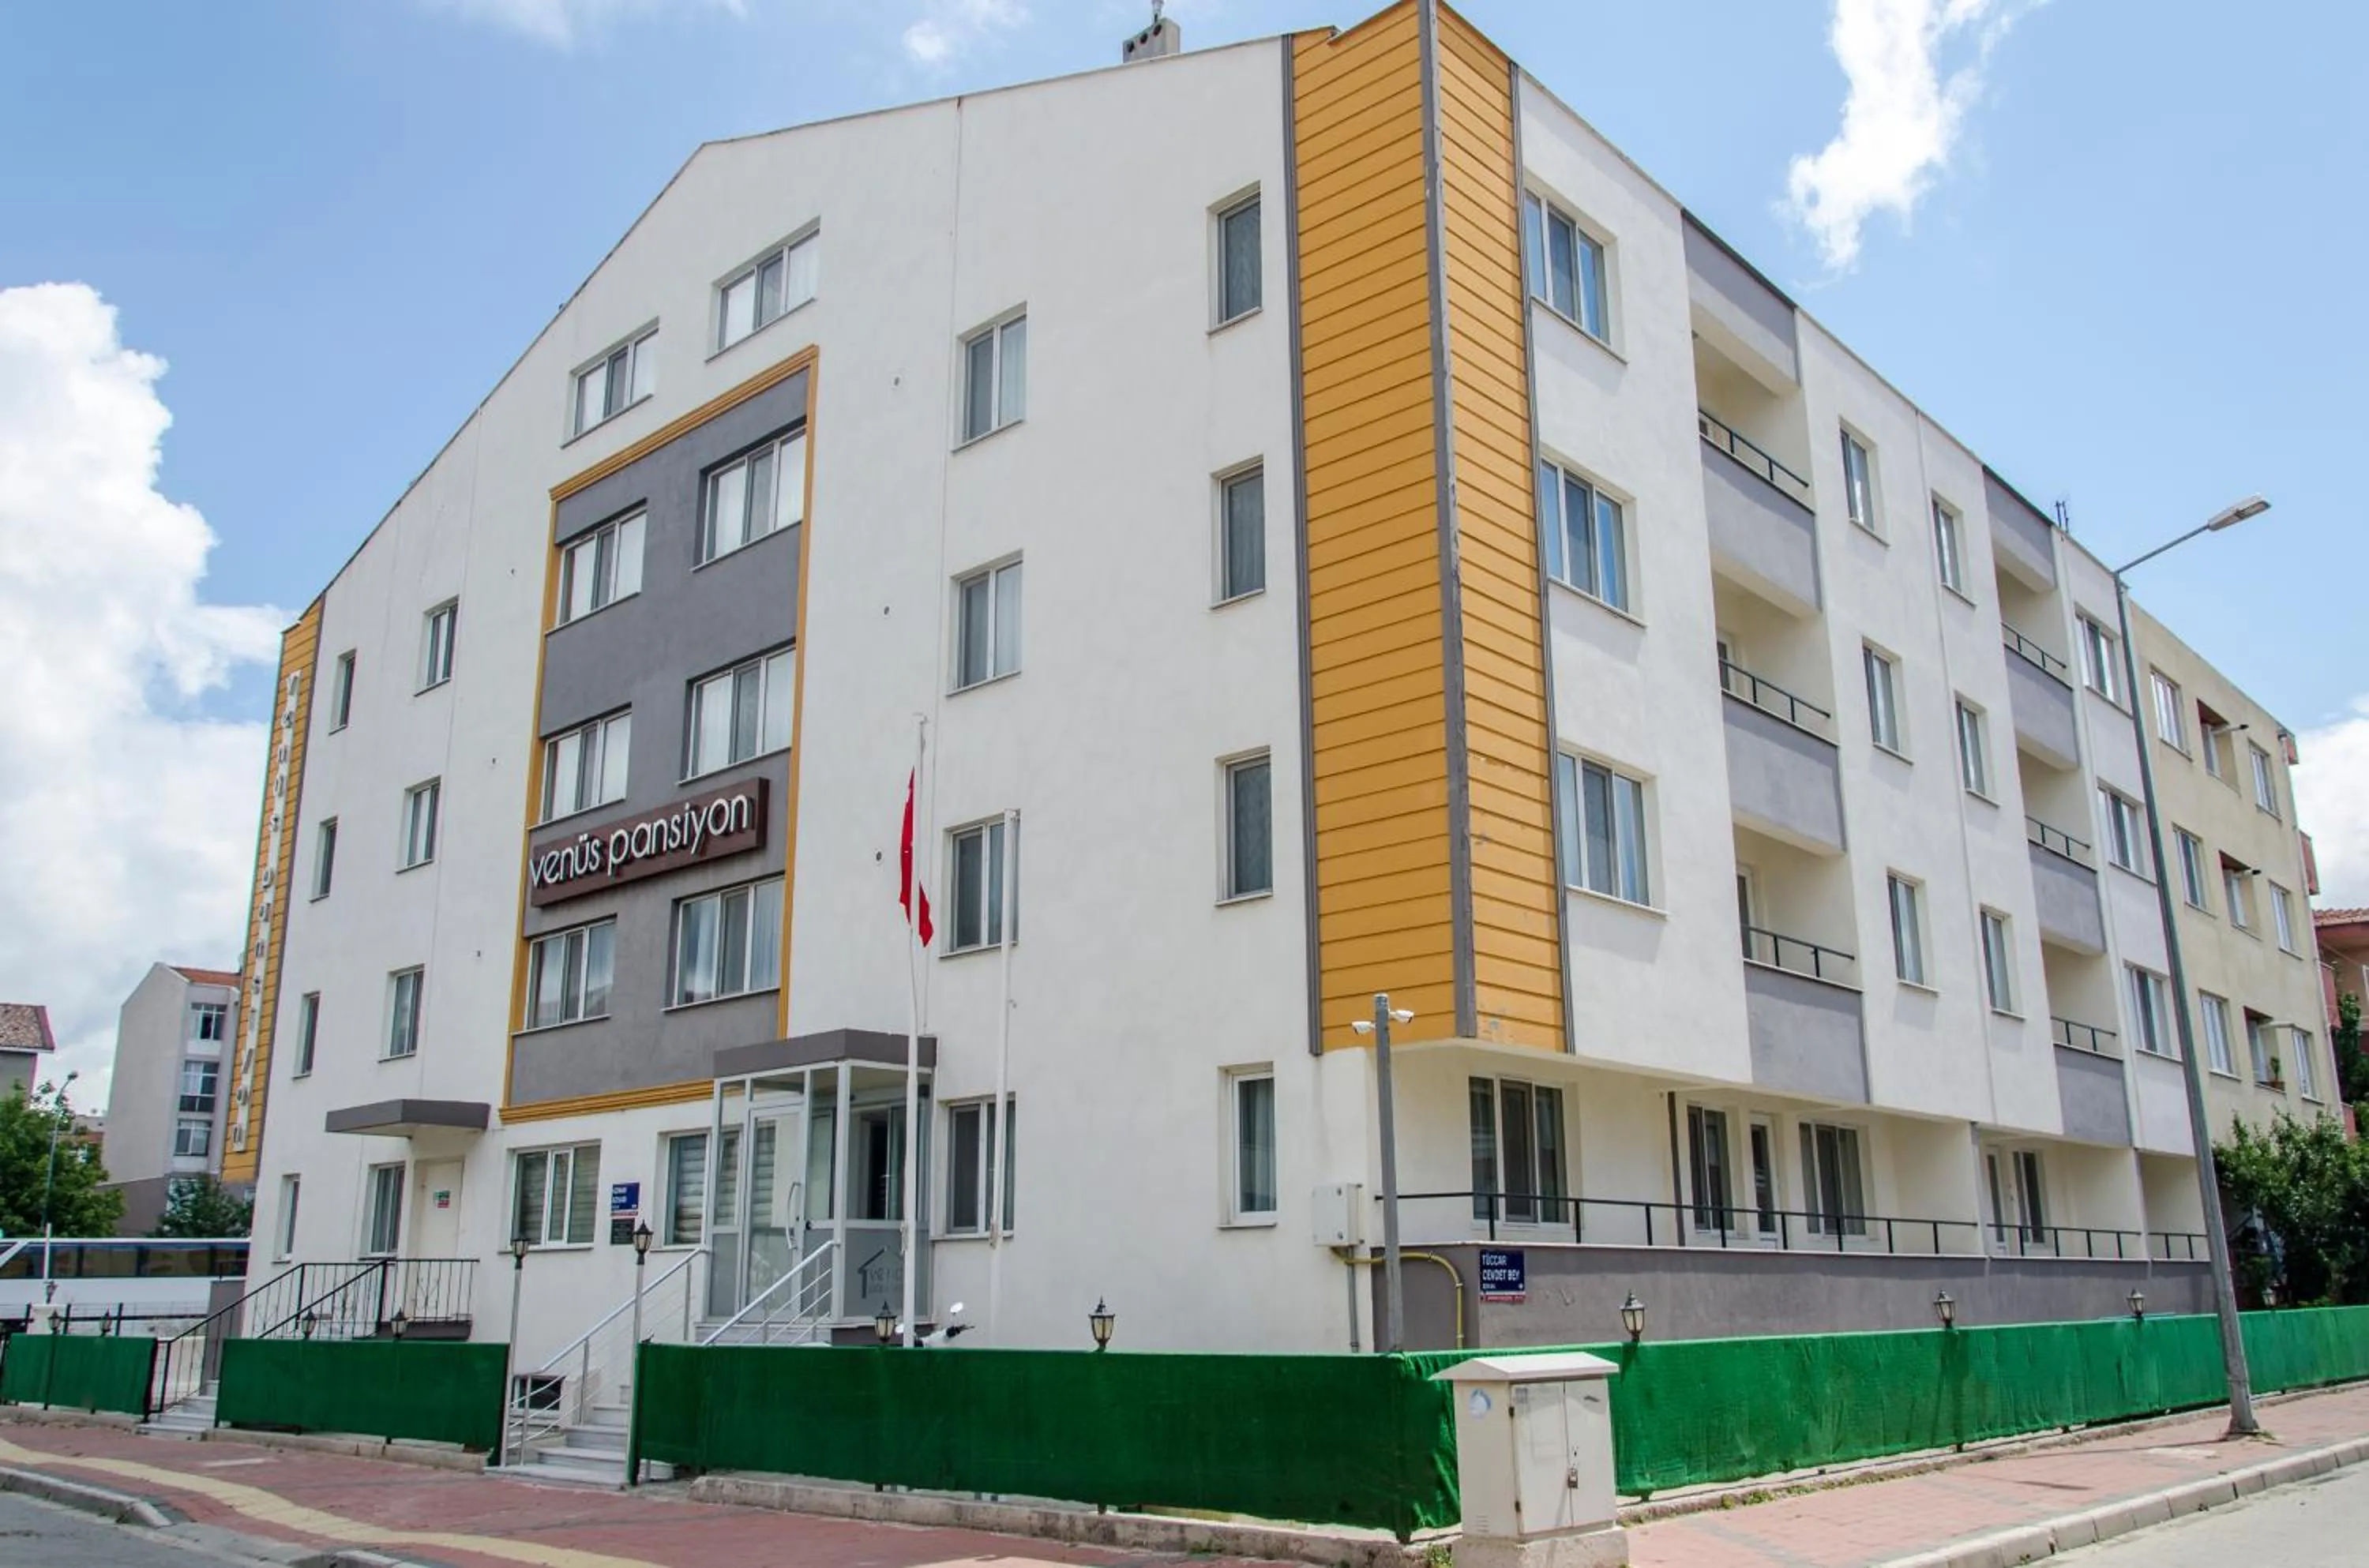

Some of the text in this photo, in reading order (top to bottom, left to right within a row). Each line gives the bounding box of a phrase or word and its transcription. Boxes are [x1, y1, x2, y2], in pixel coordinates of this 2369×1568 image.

[529, 793, 749, 887] venüs pansiyon
[1482, 1269, 1520, 1281] CEVDET BEY
